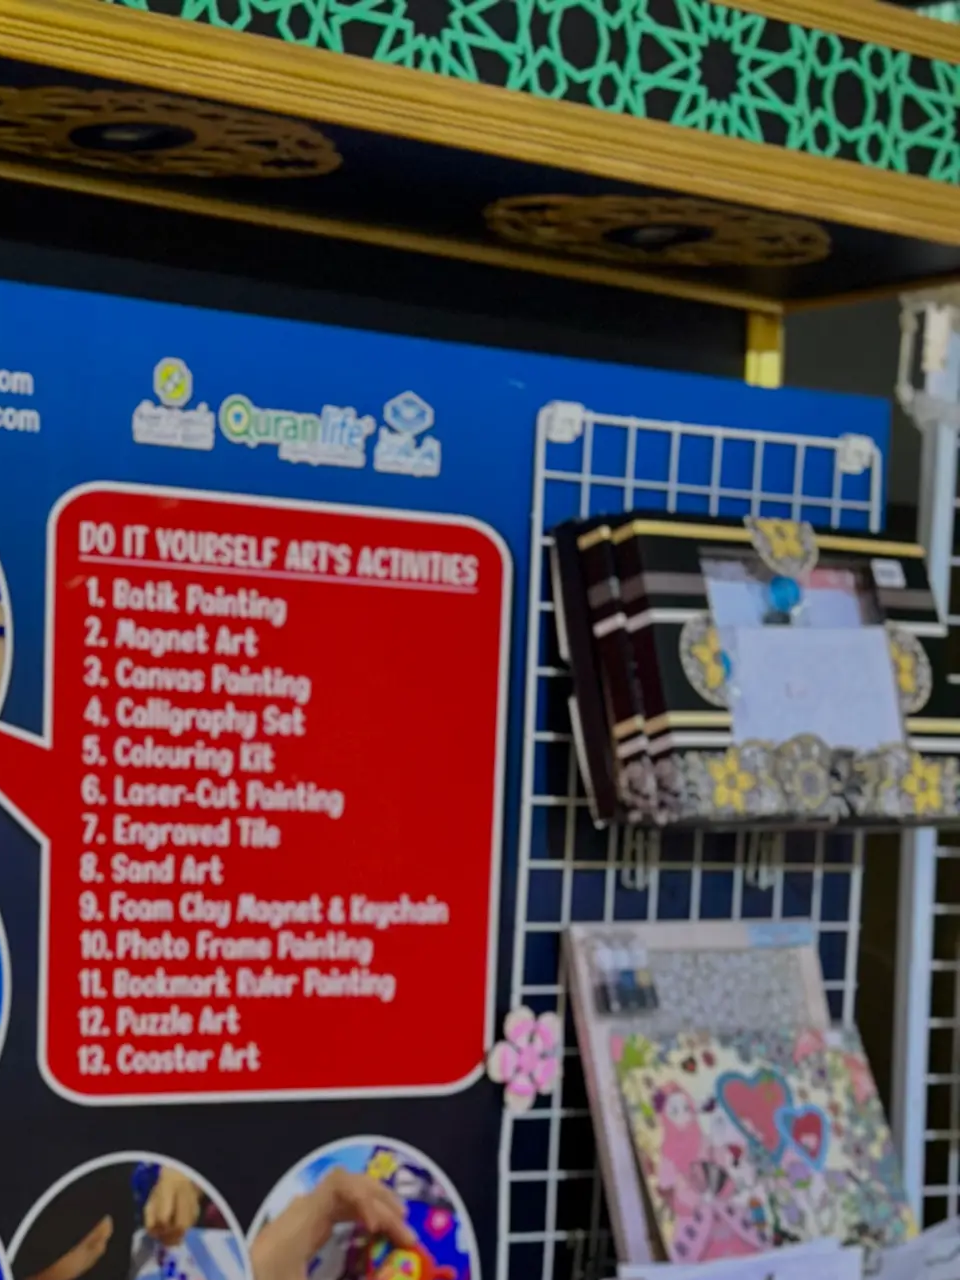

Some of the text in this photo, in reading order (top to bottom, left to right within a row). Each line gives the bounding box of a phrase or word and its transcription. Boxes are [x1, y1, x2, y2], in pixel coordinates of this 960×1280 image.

[79, 521, 479, 587] DO IT YOURSELF ART'S ACTIVITIES
[86, 576, 287, 627] 1. Batik Painting
[84, 616, 259, 657] 2. Magnet Art
[83, 655, 311, 704] 3. Canvas Painting
[83, 696, 306, 739] 4. Calligraphy Set
[82, 735, 275, 776] 5. Colouring Kit
[80, 775, 344, 819] 6. Laser-Cut Painting
[81, 814, 280, 850] 7. Engraved Tile
[80, 852, 224, 884] 8. Sand Art
[79, 891, 449, 929] 9. Foam Clay Magnet & Keychain
[80, 929, 374, 965] 10. Photo Frame Painting
[79, 966, 396, 1003] 11. Bookmark Ruler Painting
[78, 1005, 240, 1037] 12. Puzzle Art
[78, 1043, 260, 1075] 13. Coaster Art
